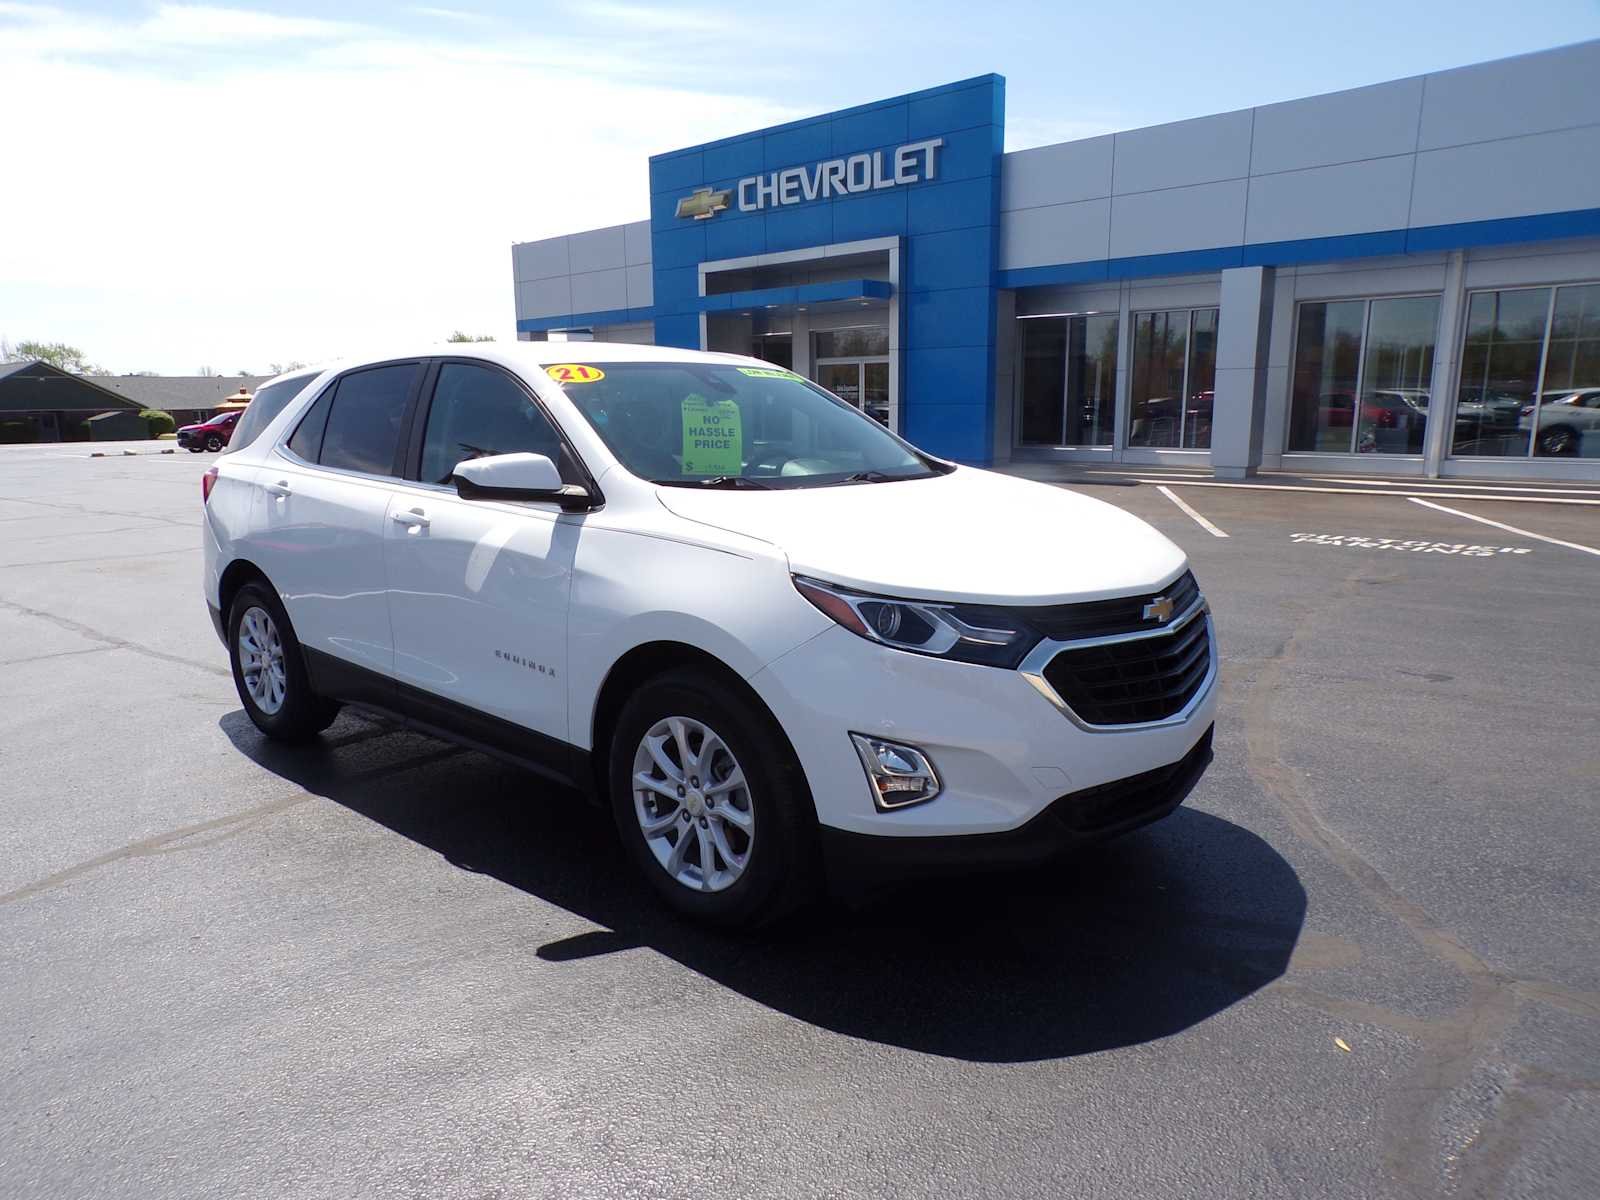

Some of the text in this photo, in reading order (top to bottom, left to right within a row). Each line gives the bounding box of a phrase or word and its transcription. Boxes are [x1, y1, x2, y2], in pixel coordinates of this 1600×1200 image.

[738, 138, 943, 212] CHEVROLET
[556, 367, 590, 380] 21
[703, 415, 720, 425] NO
[688, 427, 736, 438] HASSLE
[694, 439, 731, 449] PRICE
[1290, 533, 1532, 554] CUSTOMER
[1292, 538, 1495, 556] PARKING
[495, 649, 556, 678] EQUINOX
